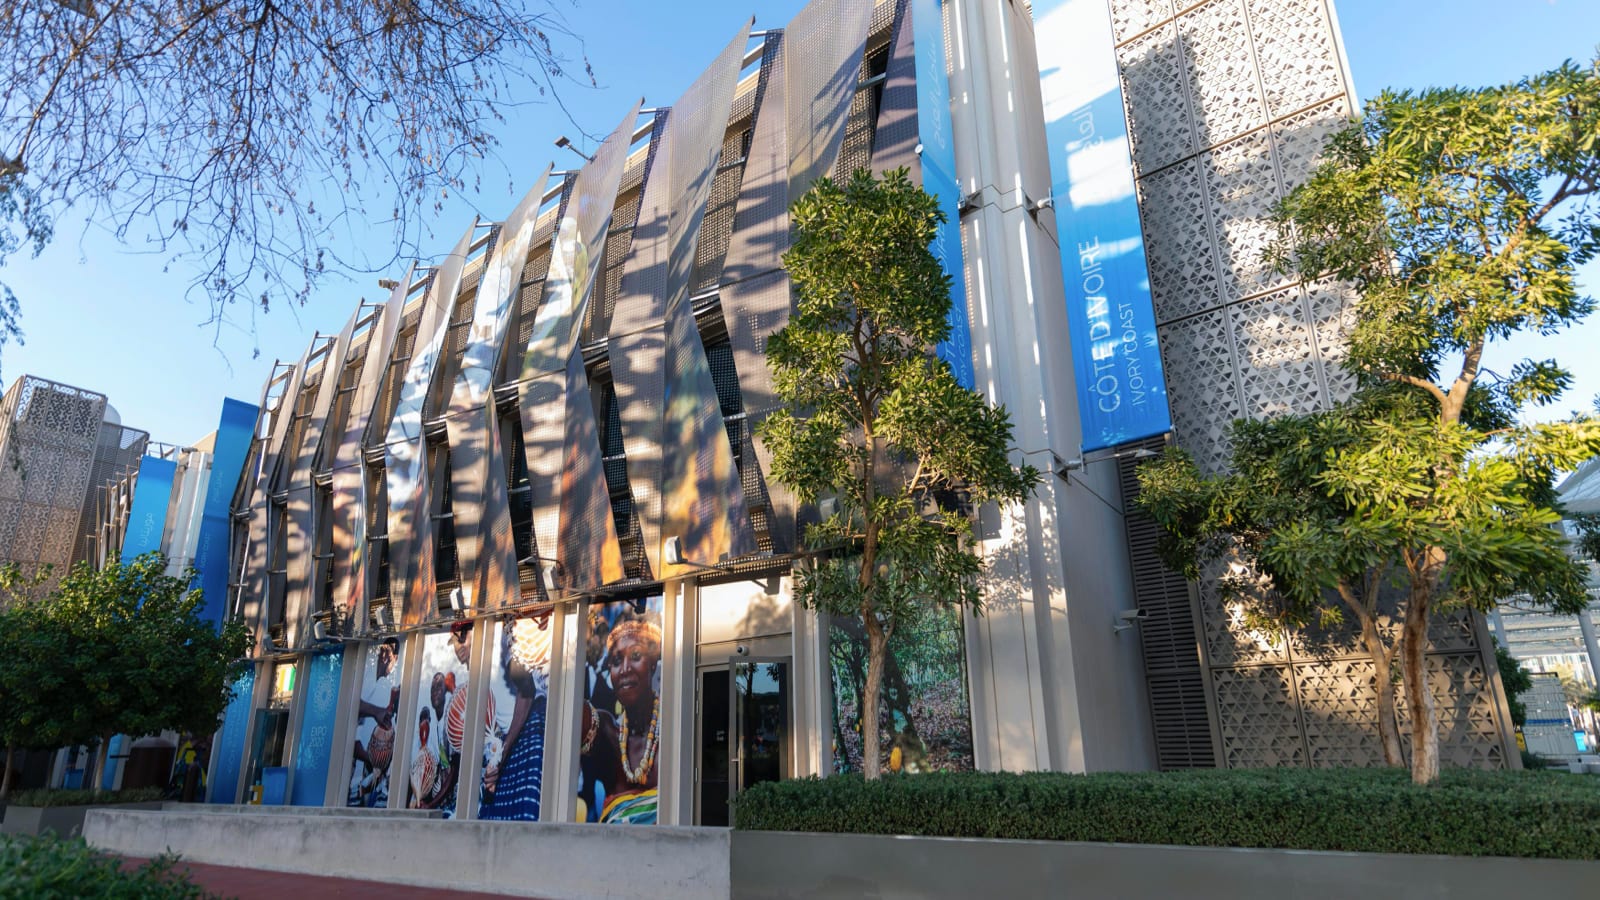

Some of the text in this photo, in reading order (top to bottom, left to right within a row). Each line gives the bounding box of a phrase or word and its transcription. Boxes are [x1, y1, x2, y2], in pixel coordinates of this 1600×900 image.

[1088, 341, 1120, 412] CÔTE
[1117, 301, 1147, 407] IVORY COAST
[311, 726, 327, 737] EXPO
